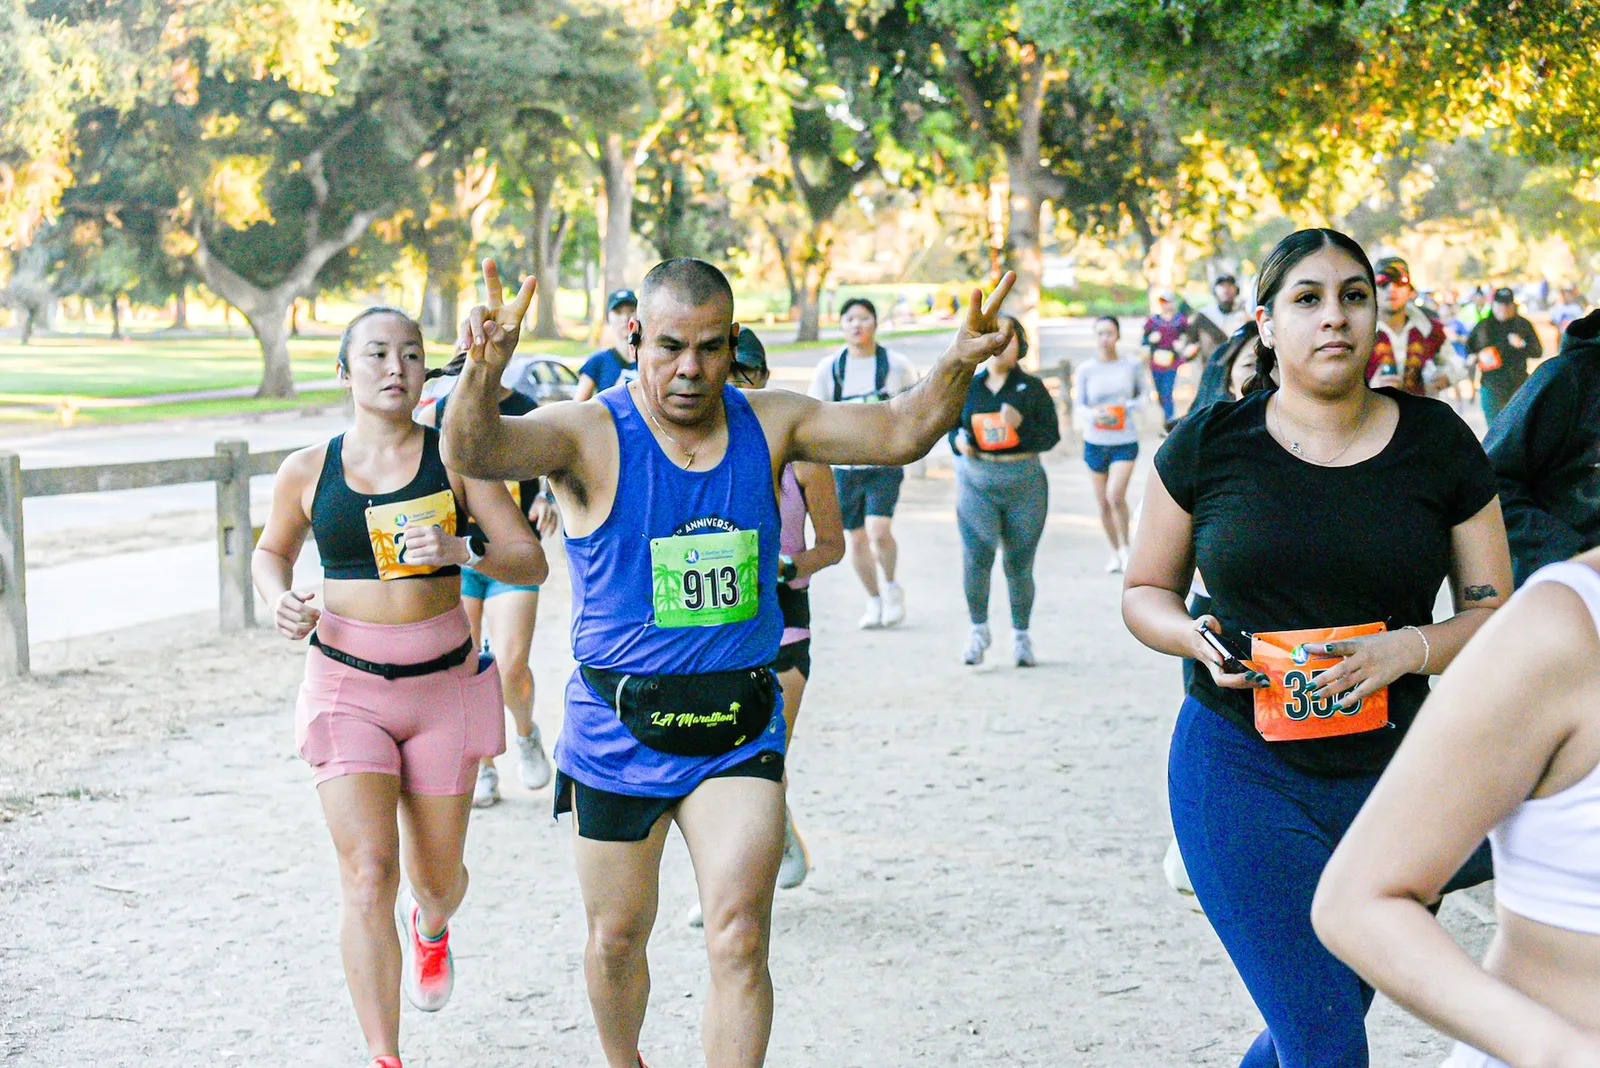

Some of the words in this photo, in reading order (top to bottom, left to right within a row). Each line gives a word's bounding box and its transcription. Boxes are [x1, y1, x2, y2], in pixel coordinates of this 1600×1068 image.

[683, 566, 738, 609] 913
[650, 711, 675, 727] LA
[676, 711, 734, 727] Marathon
